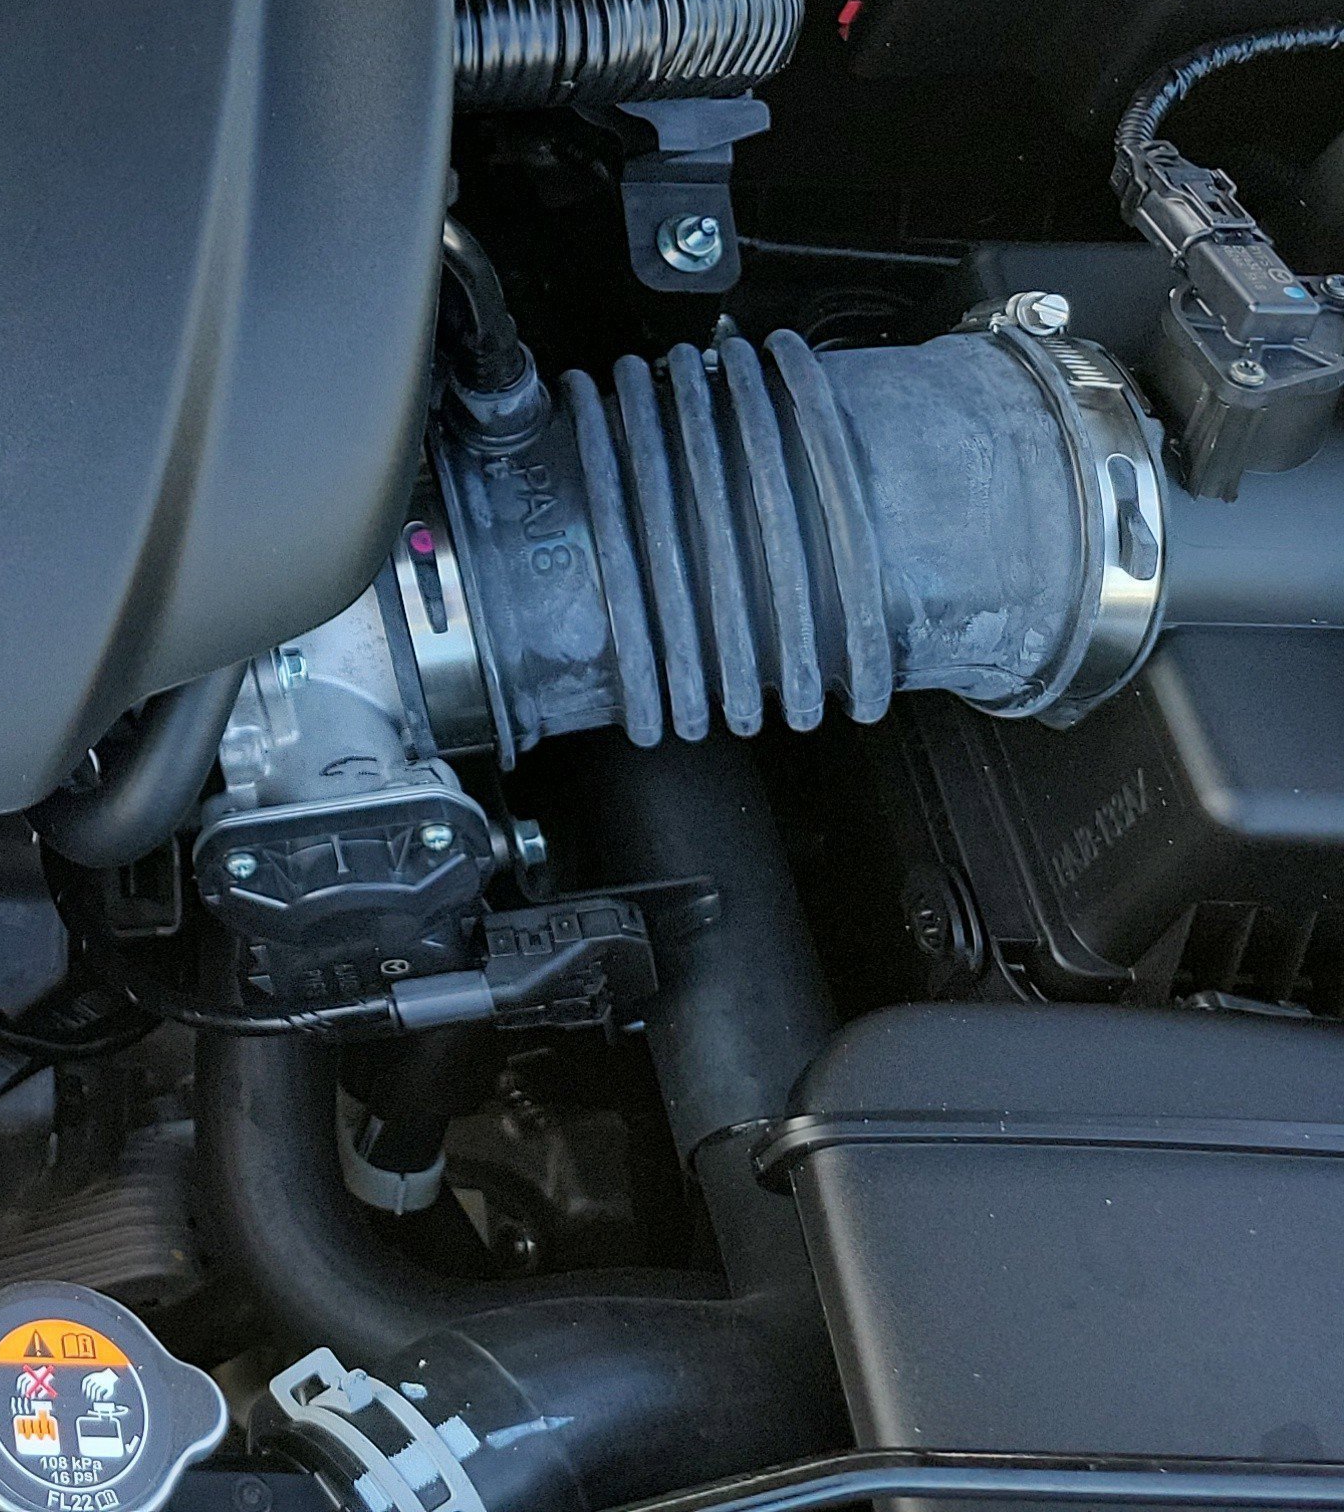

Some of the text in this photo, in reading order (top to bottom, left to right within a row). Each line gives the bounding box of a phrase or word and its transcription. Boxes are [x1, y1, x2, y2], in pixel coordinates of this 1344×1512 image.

[40, 1456, 103, 1472] 108 kPa
[50, 1468, 100, 1485] 16 psi
[46, 1490, 96, 1511] FL22
